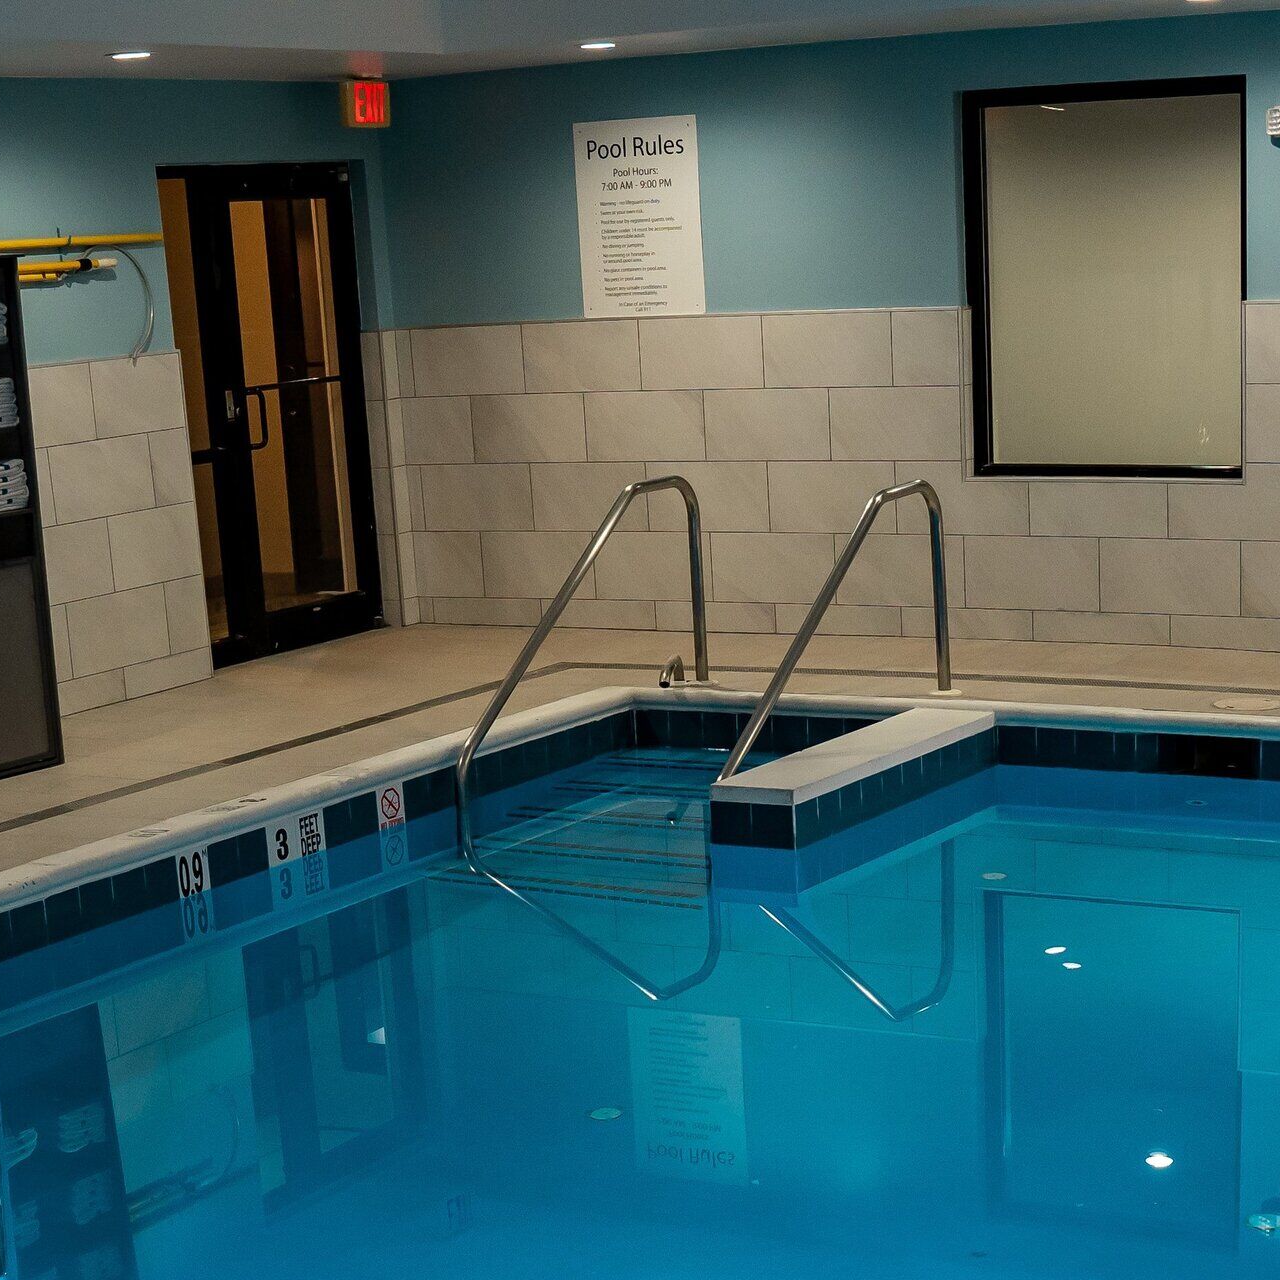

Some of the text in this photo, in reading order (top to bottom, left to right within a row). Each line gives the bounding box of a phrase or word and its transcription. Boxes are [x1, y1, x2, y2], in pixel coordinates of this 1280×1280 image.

[354, 82, 385, 123] EXIT
[586, 134, 684, 160] Pool Rules
[601, 182, 618, 191] 7:00
[620, 181, 633, 190] AM
[640, 180, 657, 189] 9:00
[659, 178, 672, 187] PM
[613, 167, 659, 178] Pool Hours:
[299, 812, 319, 837] FEET
[275, 828, 289, 860] 3
[301, 834, 321, 857] DEEP
[178, 851, 204, 898] 0.9
